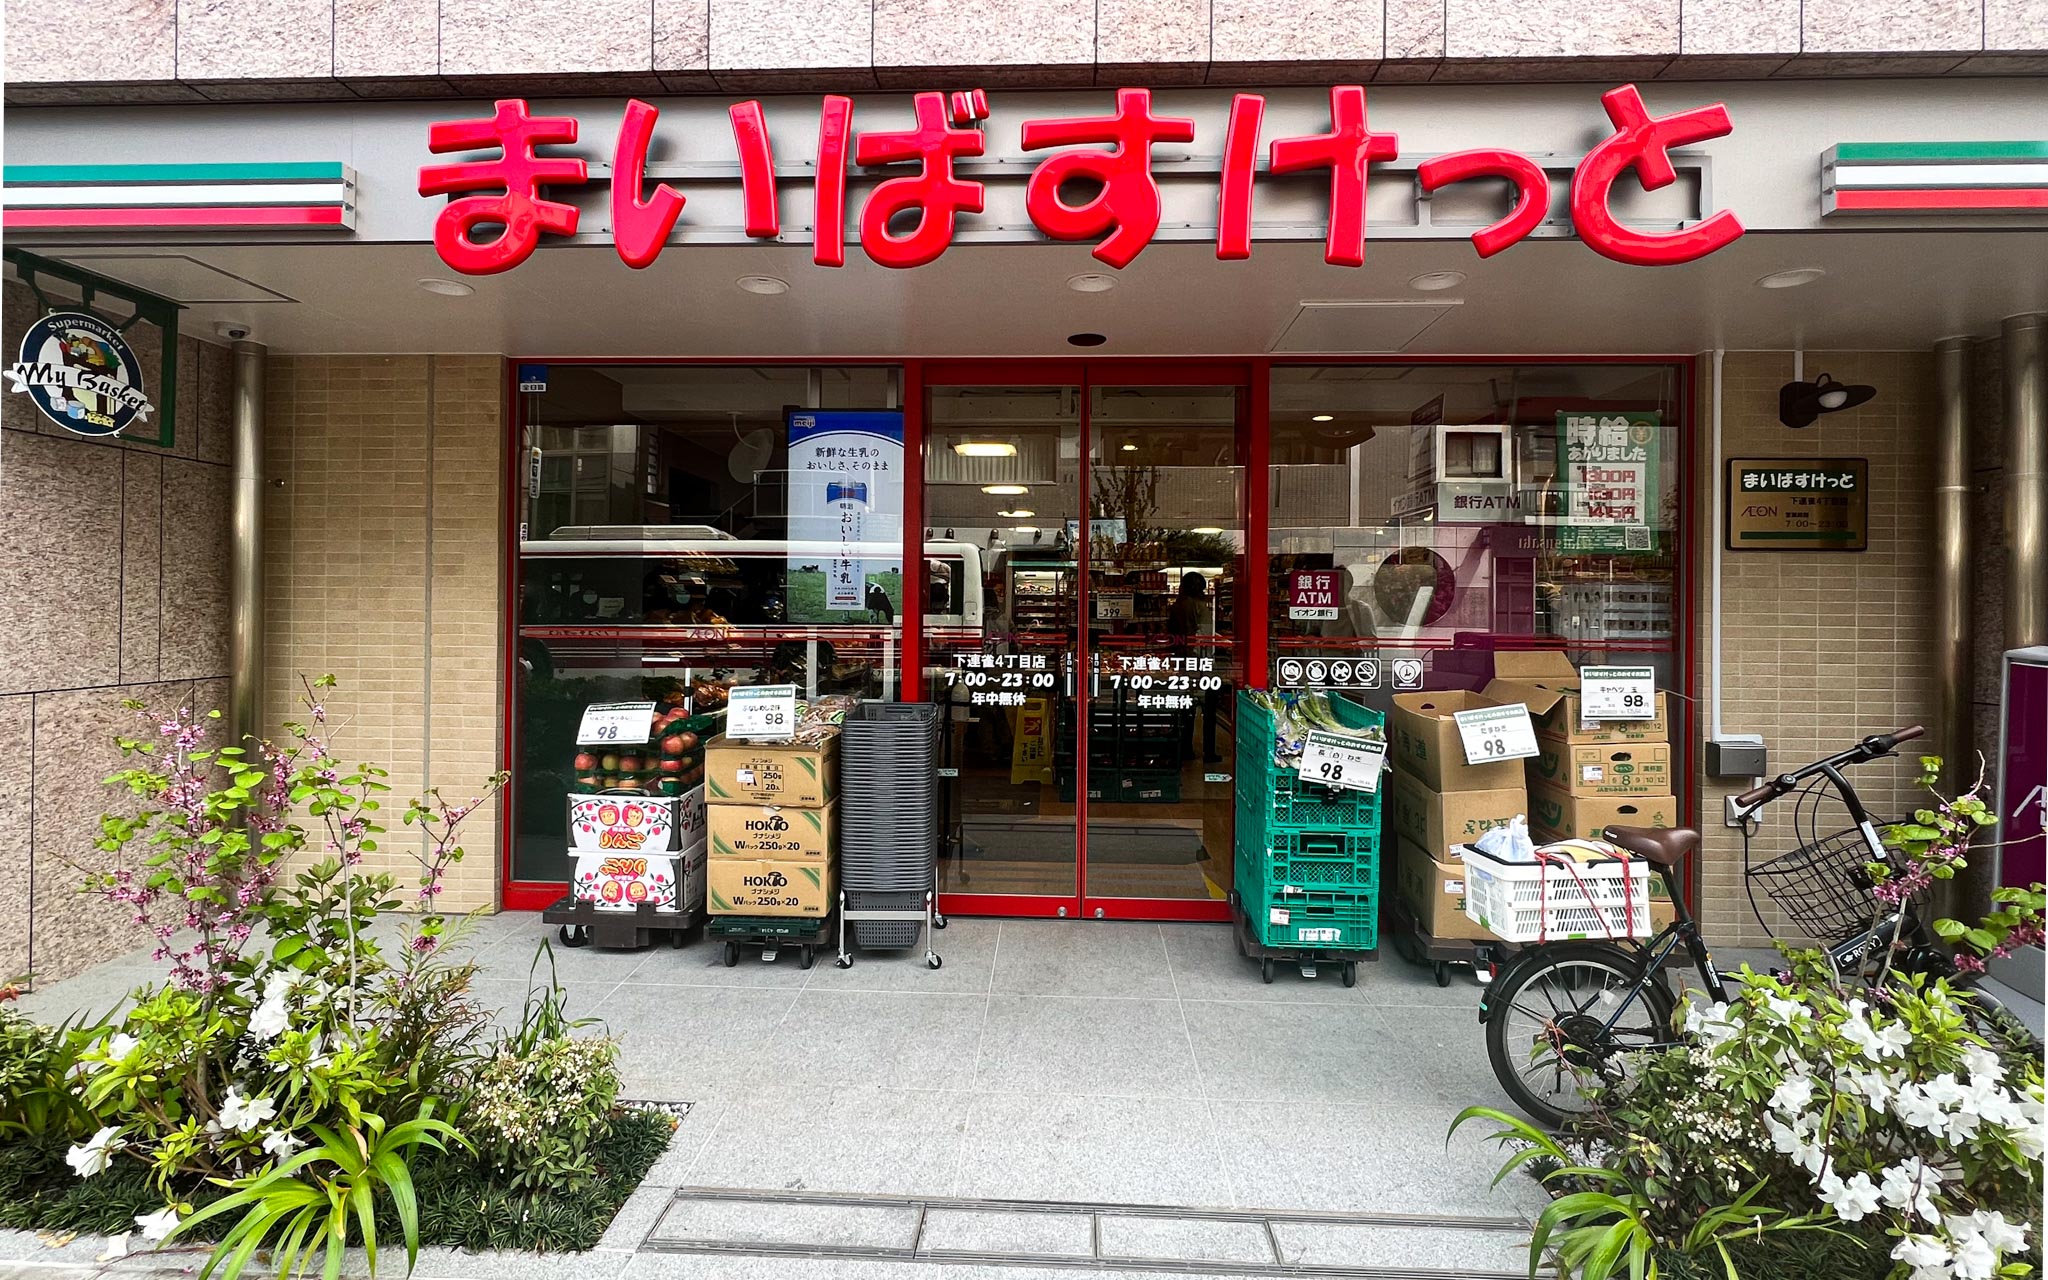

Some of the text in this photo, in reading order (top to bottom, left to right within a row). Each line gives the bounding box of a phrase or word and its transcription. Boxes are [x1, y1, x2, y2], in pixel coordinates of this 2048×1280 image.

[417, 83, 1745, 275] まいばすけっと
[48, 319, 123, 350] Supermarket
[17, 363, 146, 411] My Basket
[793, 417, 816, 429] meiji
[1566, 416, 1630, 447] 時給
[816, 447, 879, 457] 新鮮な生乳の
[1568, 446, 1647, 461] あがりました
[806, 460, 888, 471] おいしさ、そのまま
[1743, 473, 1855, 489] まいばすけっと
[1454, 495, 1520, 509] 銀行ATM
[841, 511, 853, 584] おいしい牛乳
[1298, 575, 1331, 589] 銀行
[1296, 592, 1332, 604] ATM
[1294, 609, 1333, 617] イオン銀行
[953, 654, 1046, 669] 下連雀4丁目店
[1119, 656, 1214, 672] 下連雀4丁目店
[971, 692, 1026, 706] 年中無休
[1137, 695, 1193, 709] 年中無休
[765, 712, 784, 725] 98
[598, 725, 618, 739] 98
[1480, 724, 1508, 735] たまねぎ
[1618, 722, 1628, 733] 8
[1654, 722, 1662, 730] 12
[1484, 739, 1506, 756] 98
[763, 771, 782, 780] 250g
[1320, 762, 1343, 780] 98
[1622, 774, 1630, 786] 8
[745, 815, 789, 831] HOKTO
[599, 830, 647, 849] りんご
[599, 857, 648, 878] りんご
[743, 871, 788, 887] HOKTO
[1851, 938, 1877, 958] ROY
